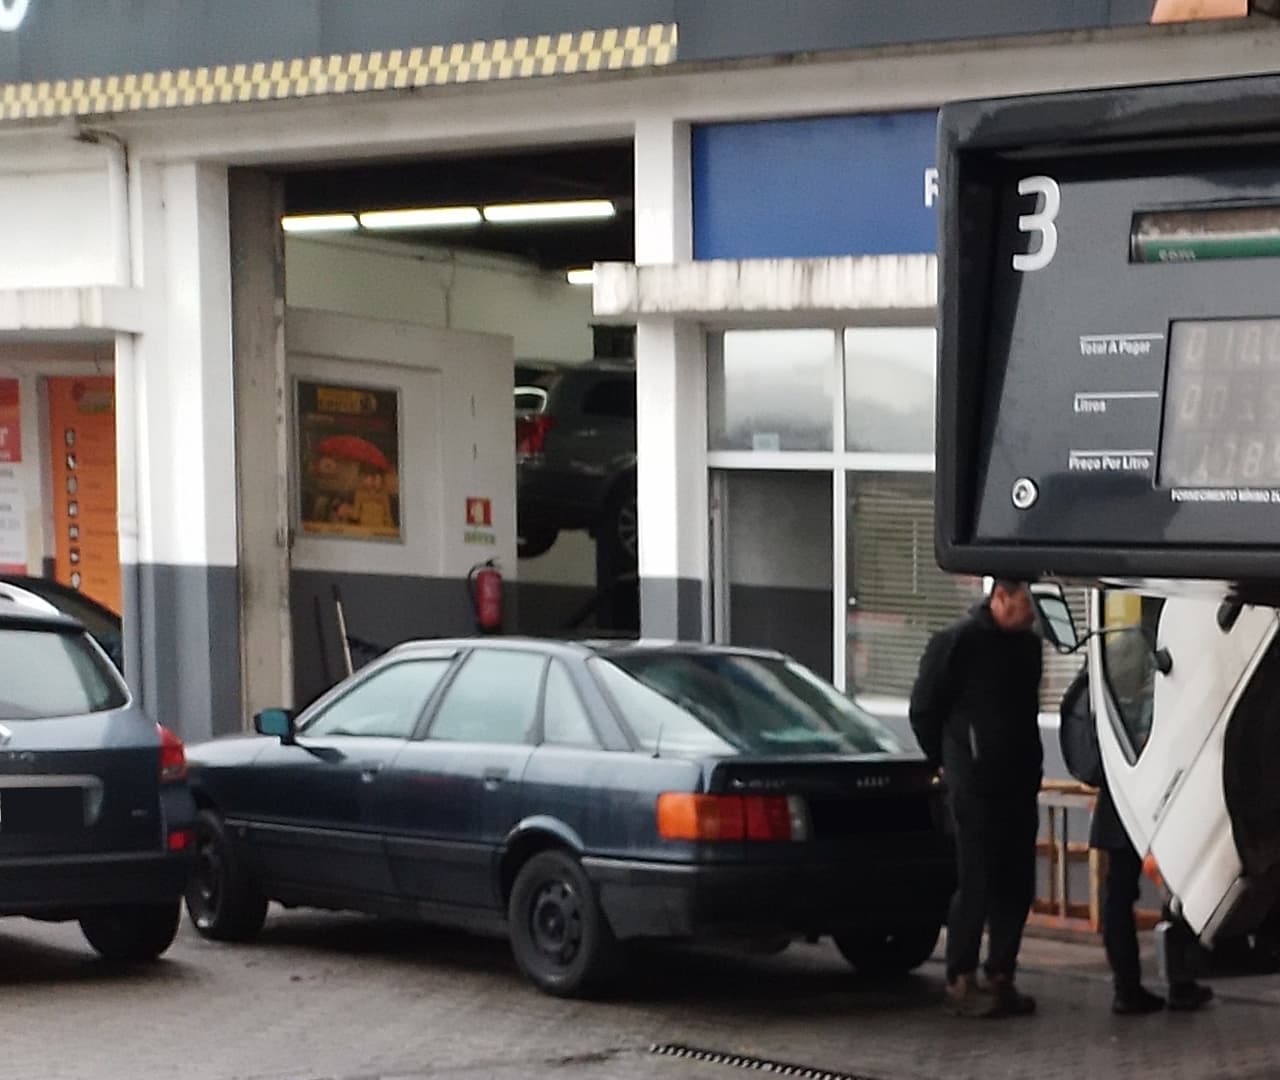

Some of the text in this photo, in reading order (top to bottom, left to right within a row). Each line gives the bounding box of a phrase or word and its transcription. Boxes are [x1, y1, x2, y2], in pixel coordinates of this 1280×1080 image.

[1012, 175, 1061, 272] 3
[1080, 340, 1107, 355] Total
[1108, 340, 1118, 354] A
[1073, 398, 1106, 412] Litros
[1069, 456, 1150, 471] Preço Por Litro
